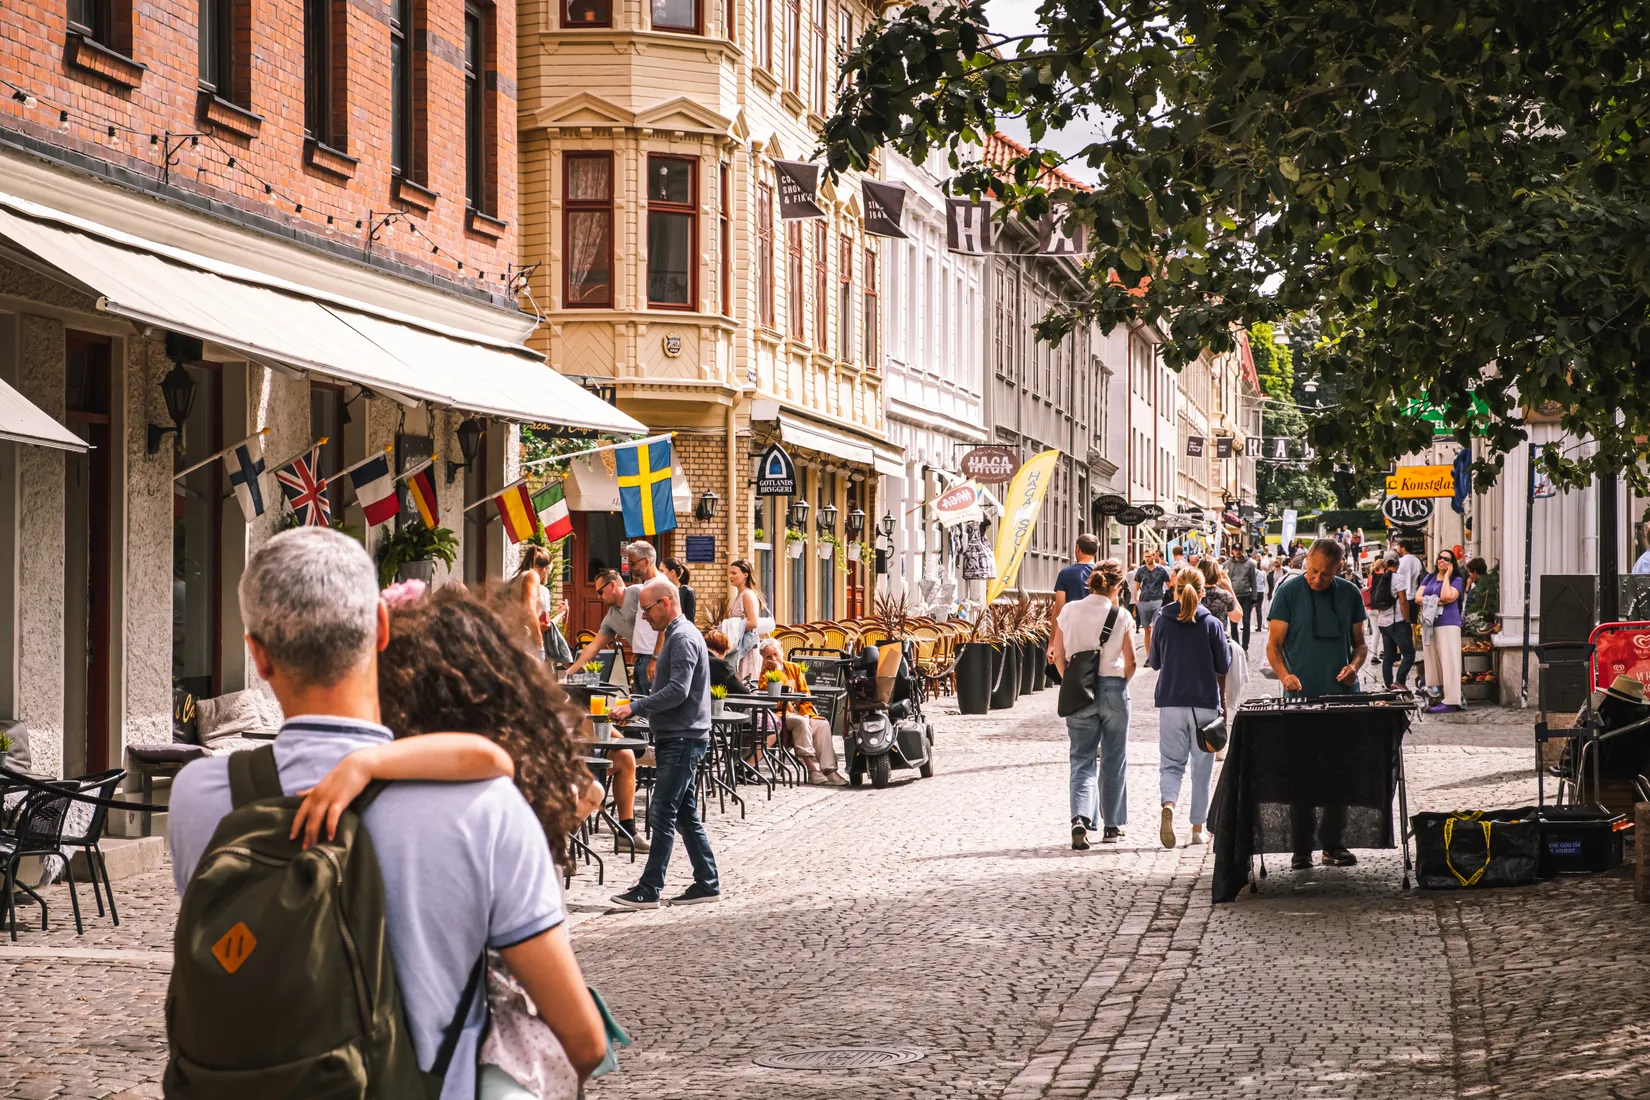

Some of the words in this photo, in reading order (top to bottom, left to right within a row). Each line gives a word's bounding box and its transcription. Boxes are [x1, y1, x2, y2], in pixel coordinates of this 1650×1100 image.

[784, 196, 790, 204] &
[968, 456, 1012, 474] HAGA
[759, 479, 793, 487] GOTLANDS
[1022, 470, 1041, 507] HAGA
[1391, 499, 1428, 517] PACS
